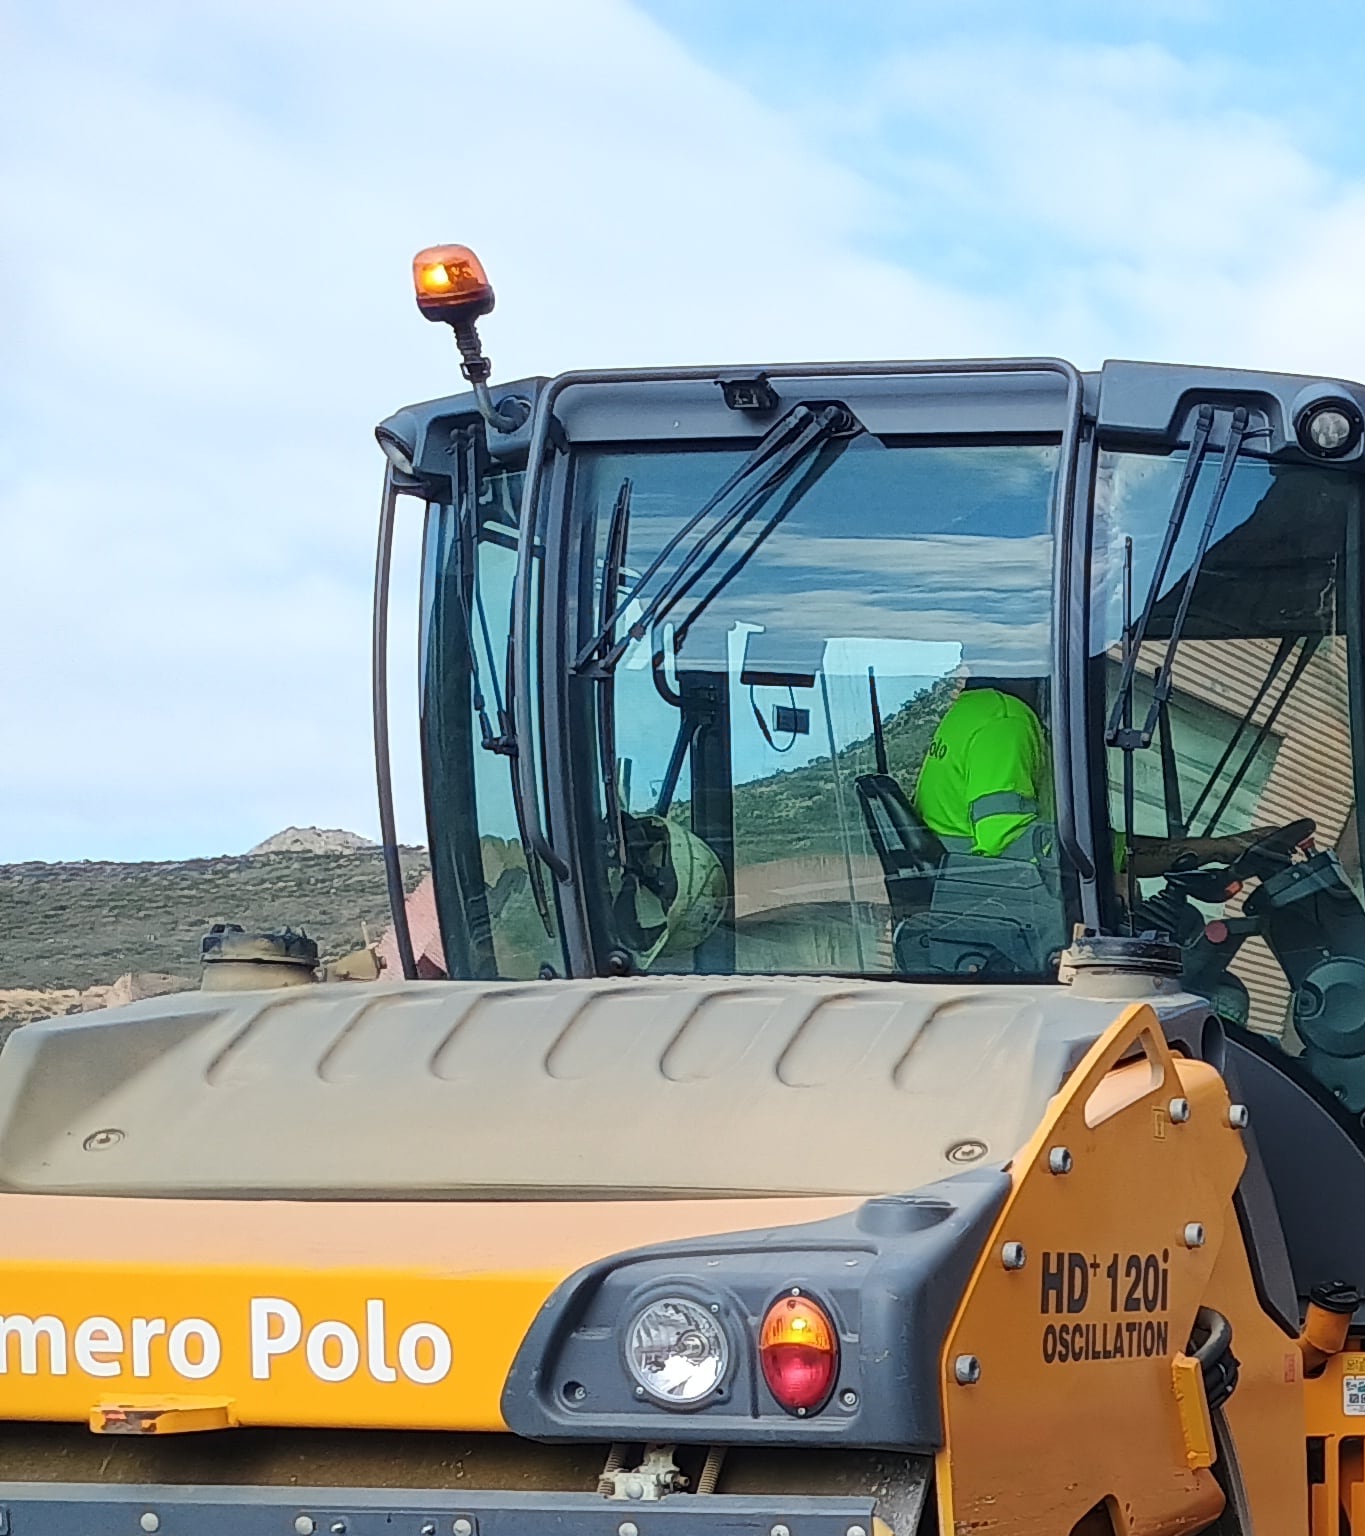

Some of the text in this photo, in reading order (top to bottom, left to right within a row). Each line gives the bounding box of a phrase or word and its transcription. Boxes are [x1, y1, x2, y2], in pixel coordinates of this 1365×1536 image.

[928, 737, 949, 761] olo
[1106, 1247, 1170, 1313] 120i
[249, 1296, 453, 1384] Polo
[1042, 1320, 1169, 1364] OSCILLATION
